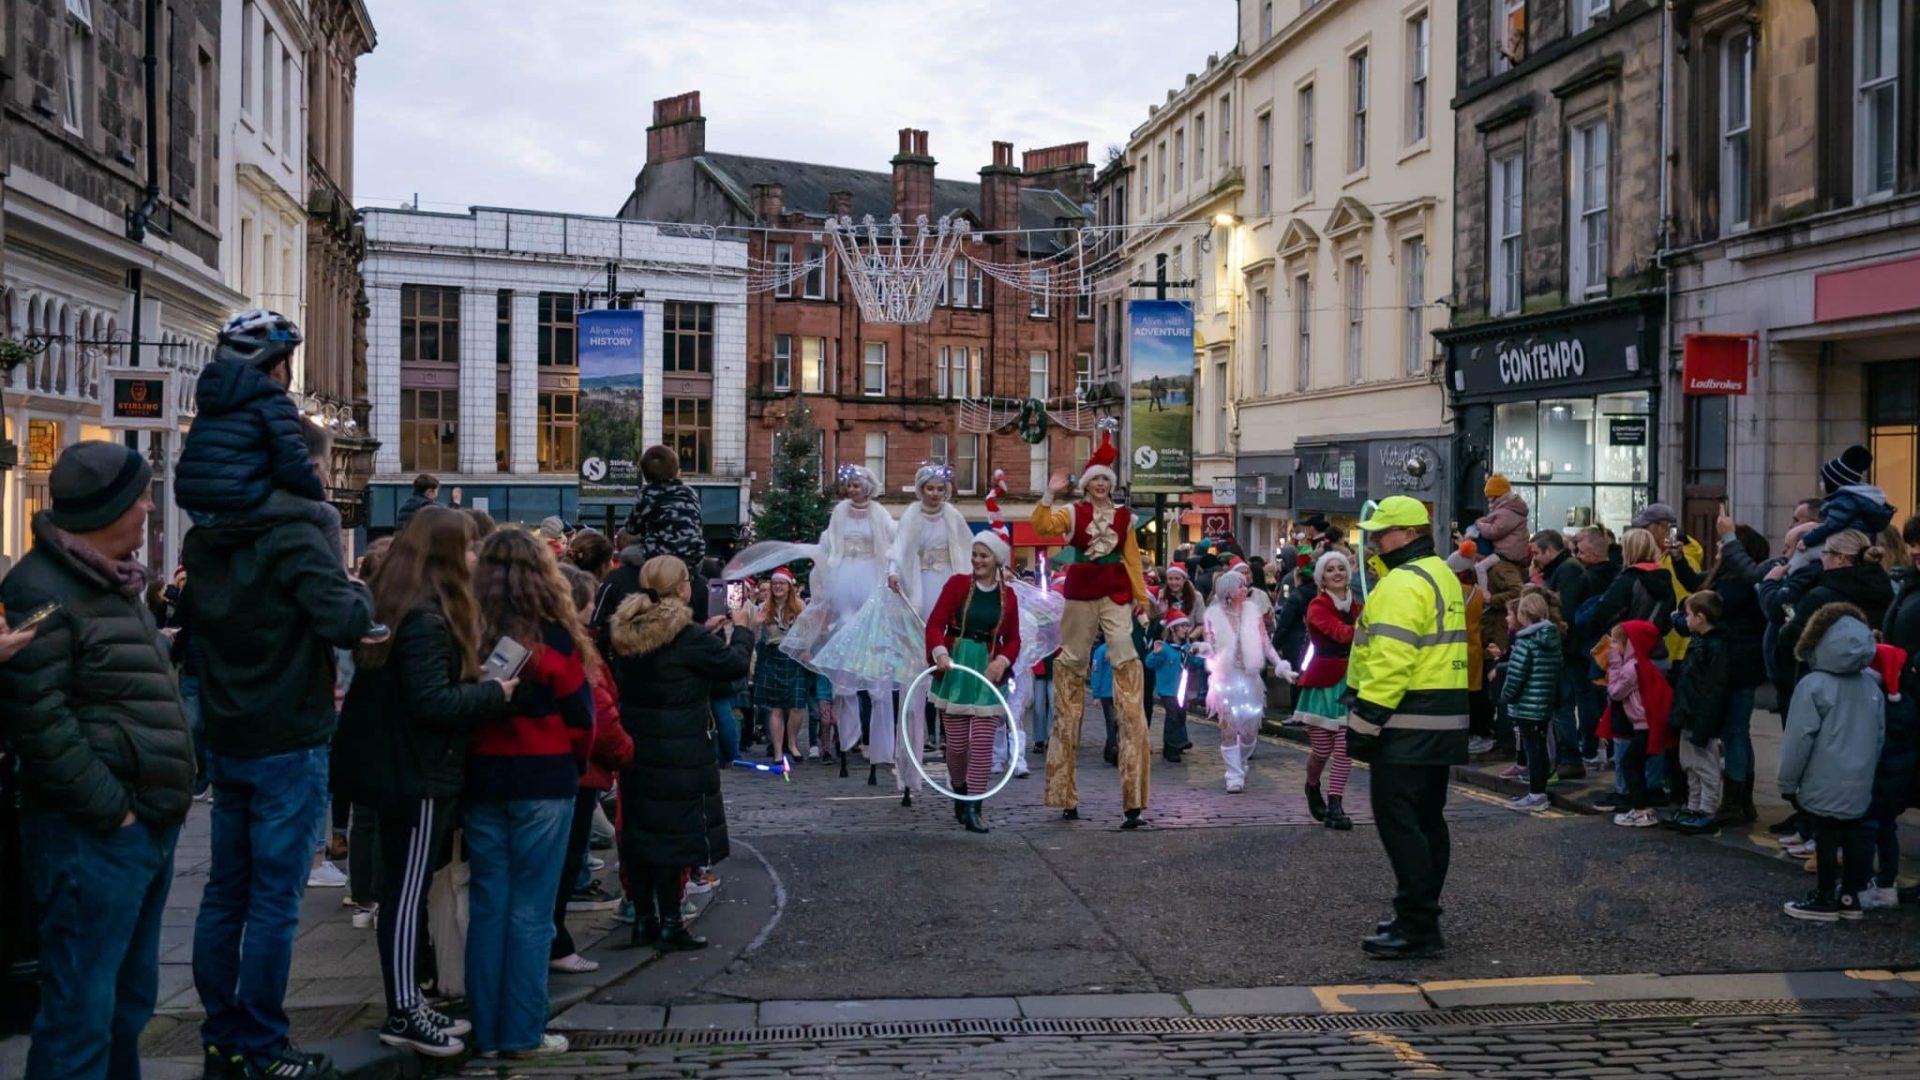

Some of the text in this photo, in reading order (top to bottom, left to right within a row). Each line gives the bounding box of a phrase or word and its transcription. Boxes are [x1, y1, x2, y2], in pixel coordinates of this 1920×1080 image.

[589, 325, 633, 335] Alive with
[1135, 327, 1191, 337] ADVENTURE
[590, 337, 632, 346] HISTORY
[1499, 338, 1584, 384] CONTEMPO
[1690, 377, 1742, 390] Ladbrokes
[118, 402, 159, 410] STIRLING
[610, 459, 633, 467] Stirling
